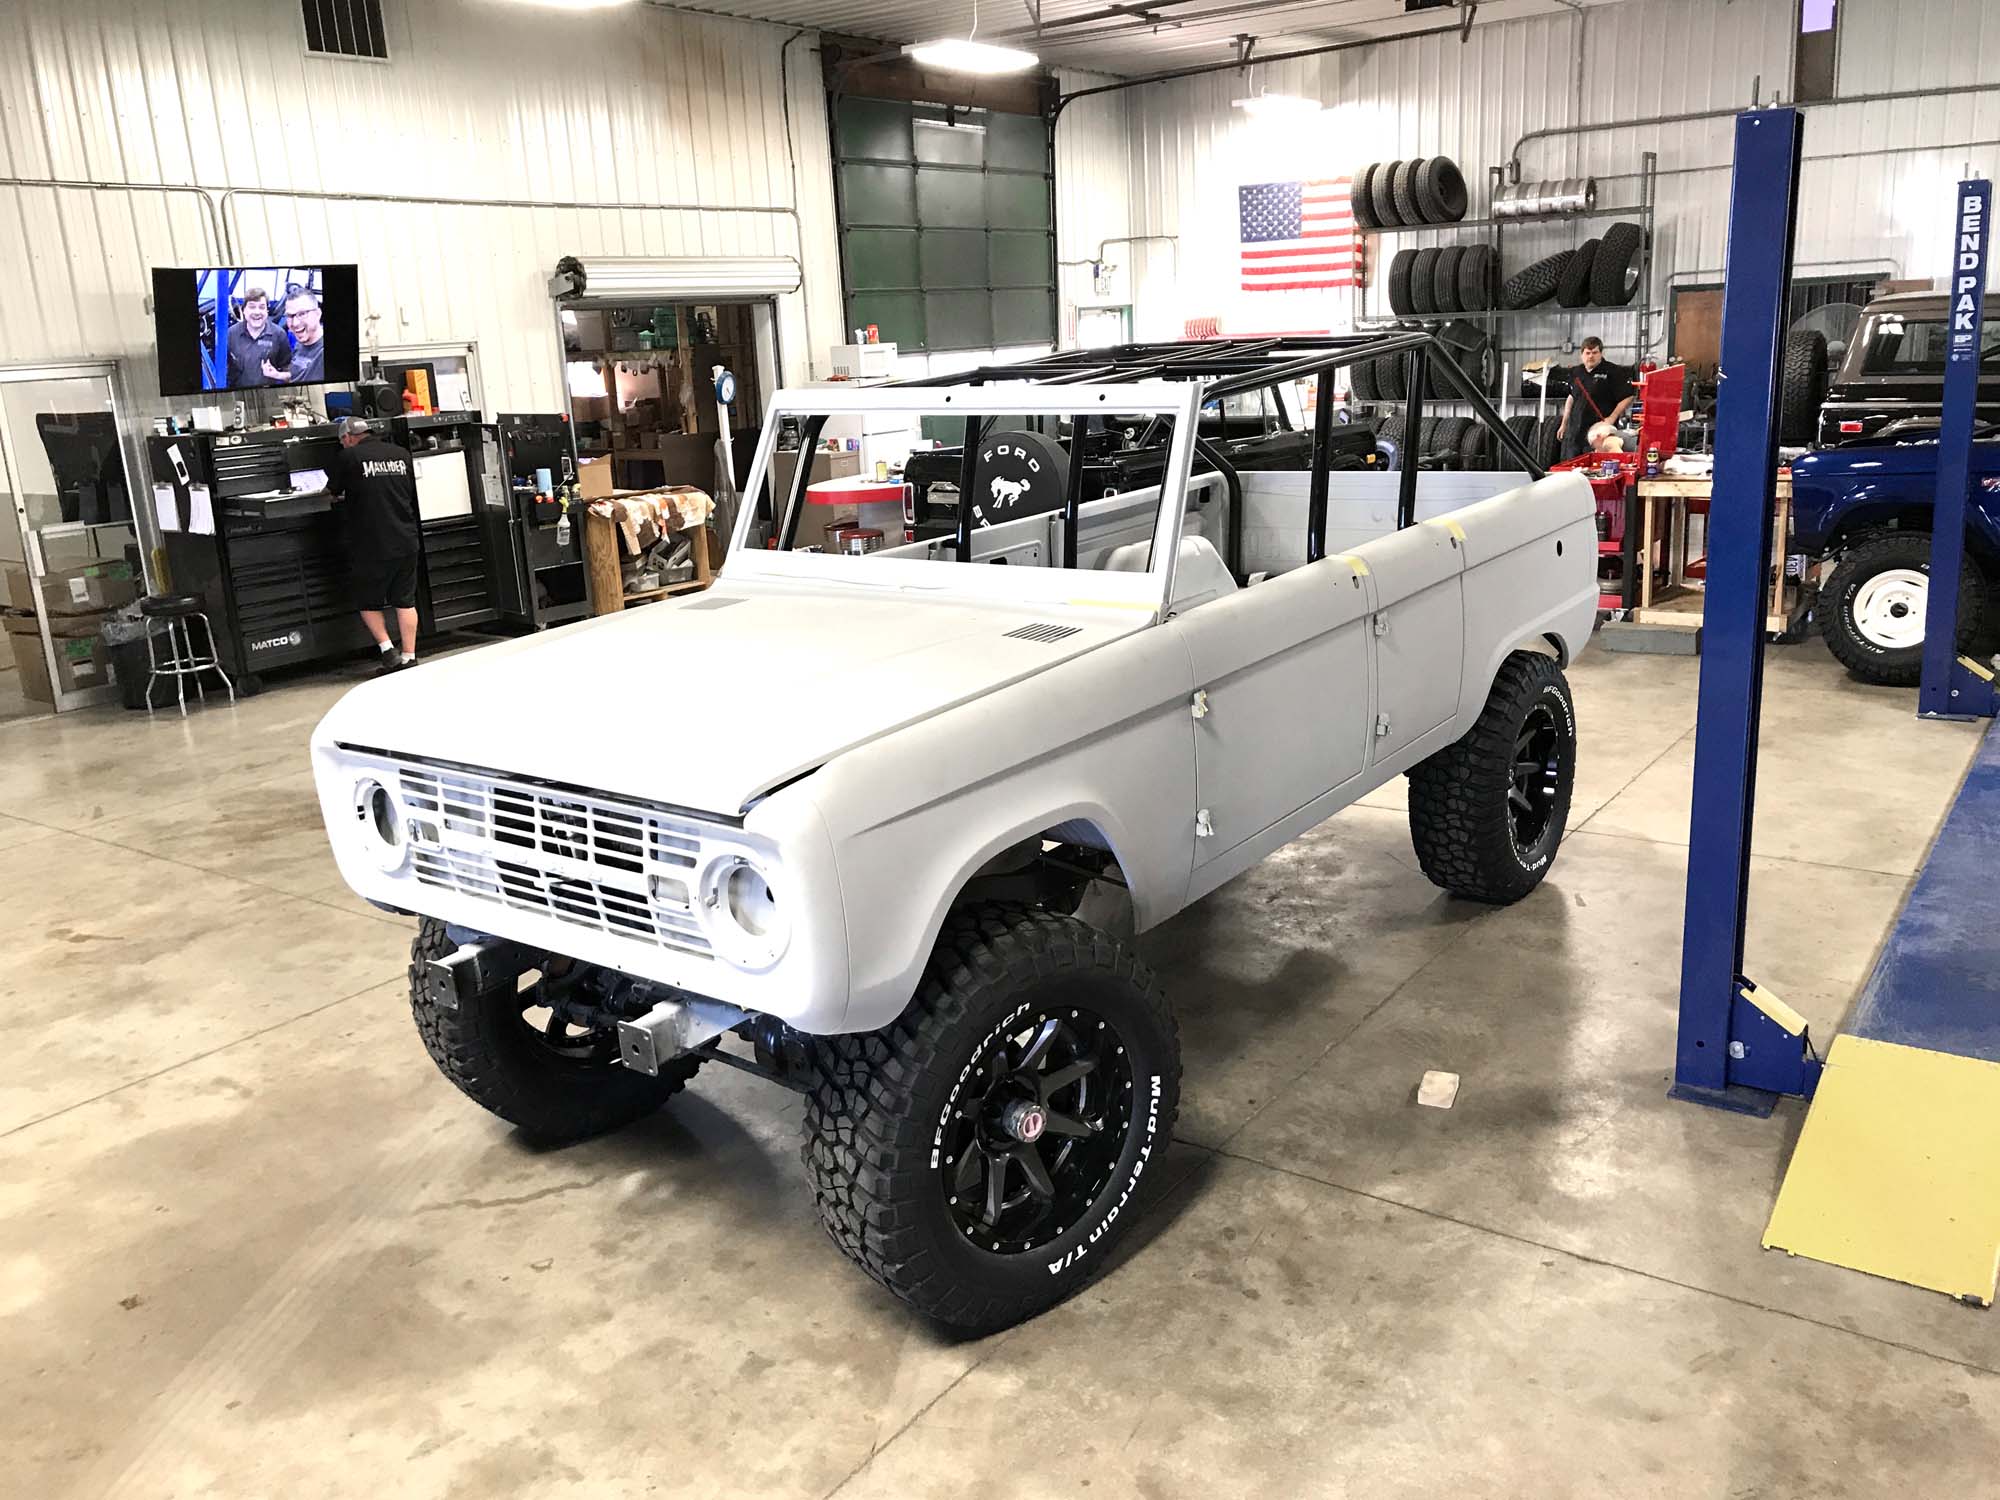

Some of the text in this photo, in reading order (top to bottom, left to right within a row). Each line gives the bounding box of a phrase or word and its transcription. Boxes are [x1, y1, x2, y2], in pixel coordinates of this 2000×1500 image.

[983, 444, 1041, 473] FORD
[251, 636, 288, 651] MATCO
[930, 1002, 1031, 1169] BFGoodrich
[1048, 1075, 1161, 1275] Mud-Terrain T/A
